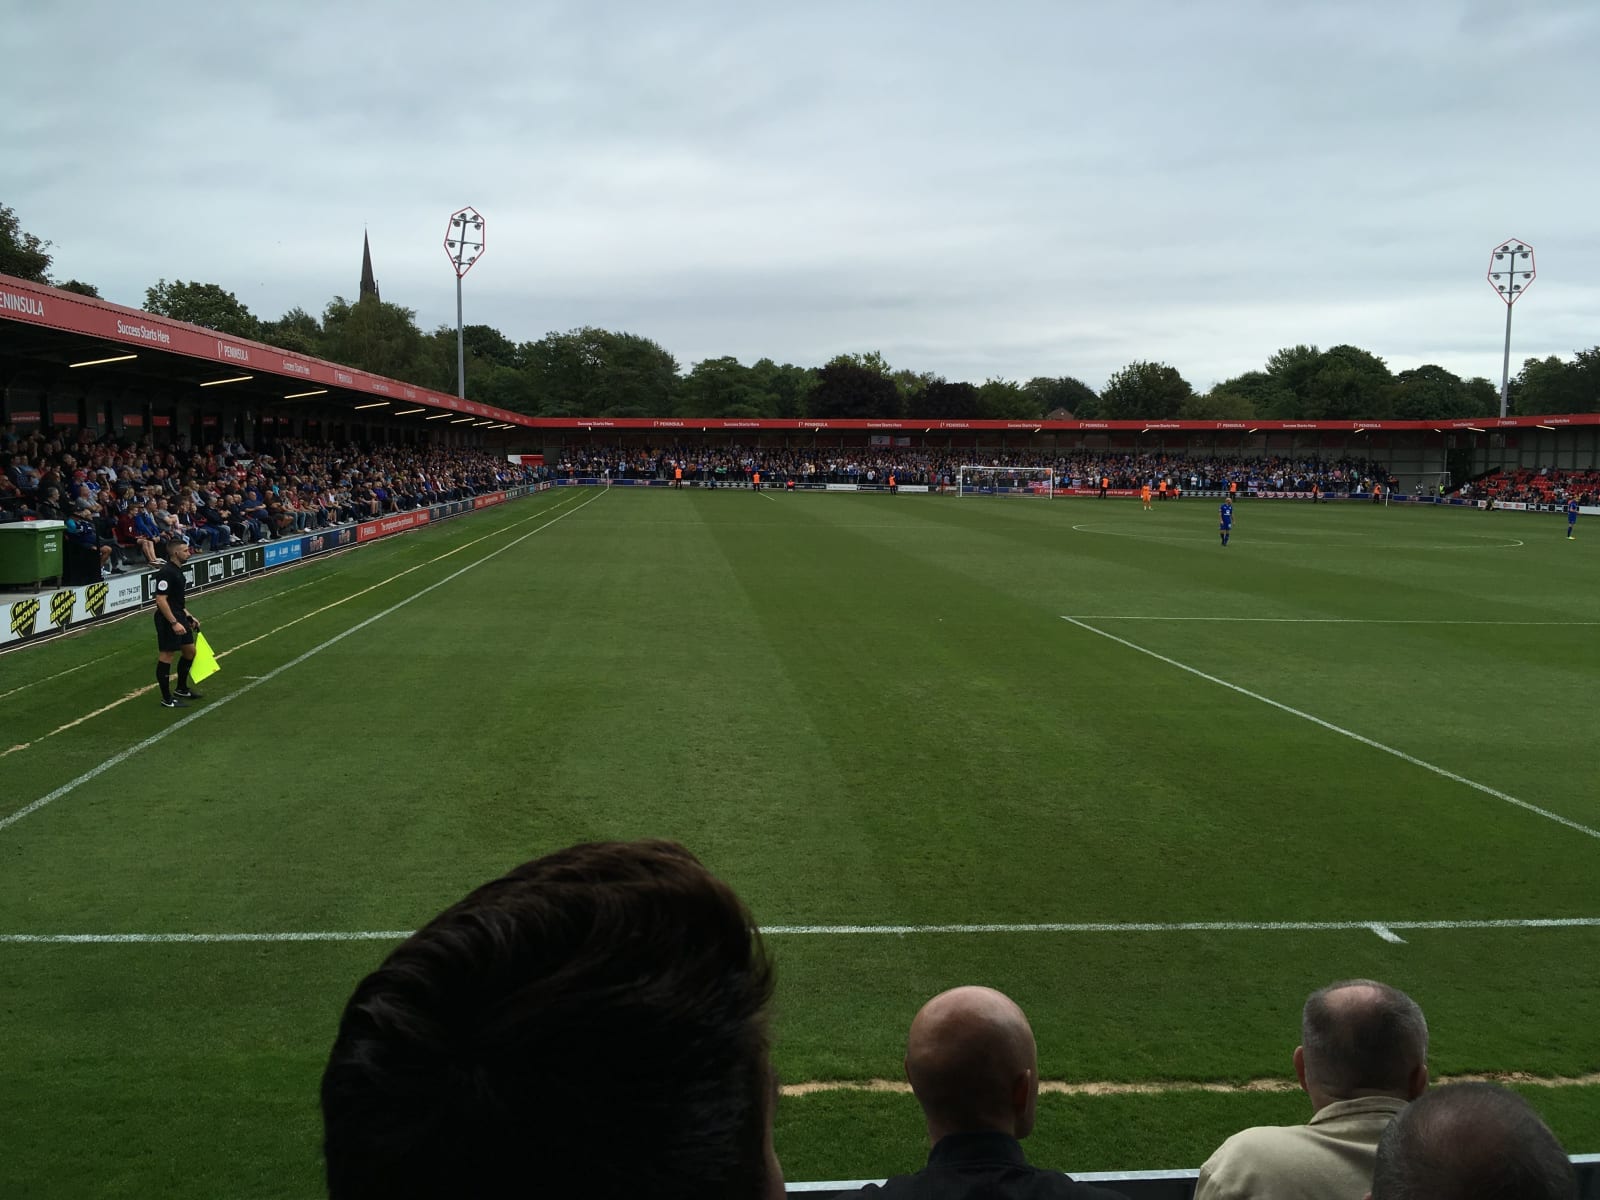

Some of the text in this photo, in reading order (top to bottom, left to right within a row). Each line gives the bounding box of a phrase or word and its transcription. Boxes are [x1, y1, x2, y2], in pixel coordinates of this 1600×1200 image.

[116, 320, 171, 344] Success Starts Here
[224, 345, 249, 361] PENINSULA
[15, 599, 33, 615] M&A
[50, 594, 76, 622] BROWN
[54, 590, 70, 607] M&A
[85, 585, 109, 610] BROWN
[11, 601, 40, 632] BROWN
